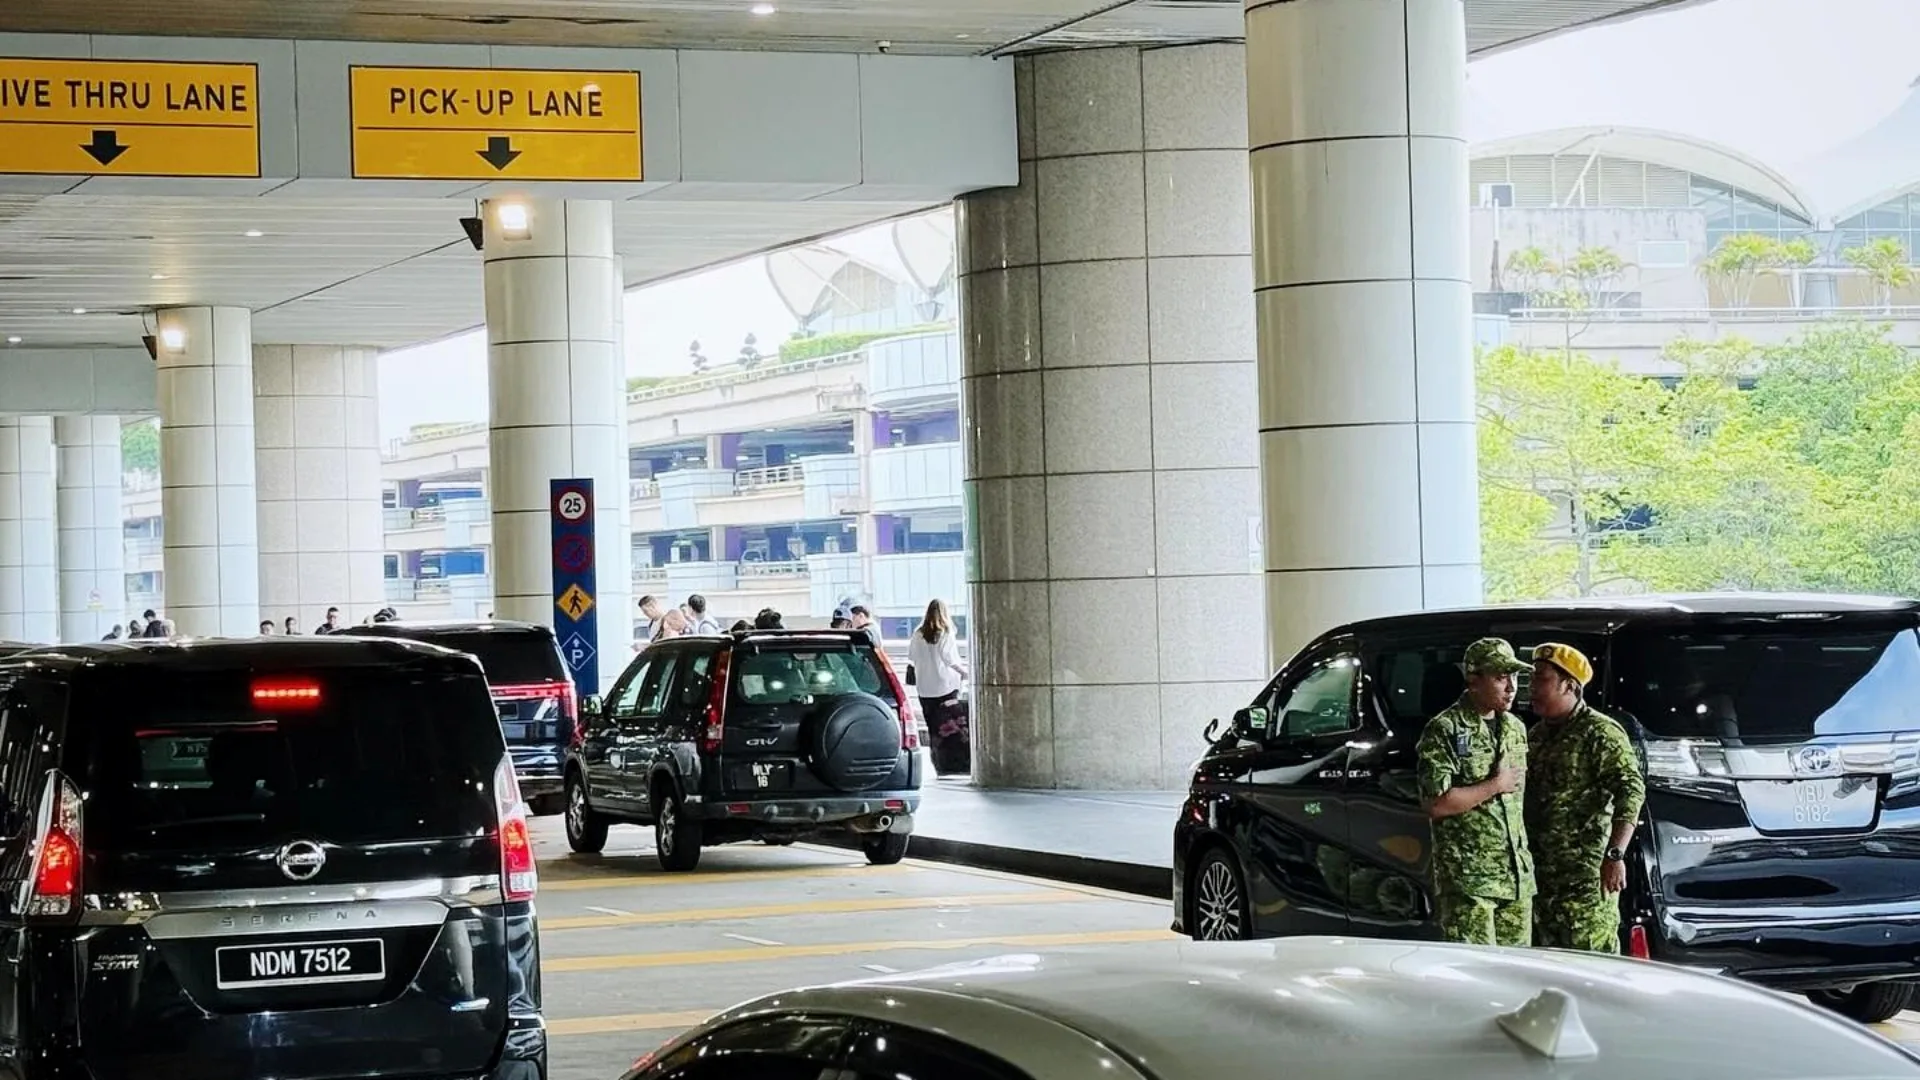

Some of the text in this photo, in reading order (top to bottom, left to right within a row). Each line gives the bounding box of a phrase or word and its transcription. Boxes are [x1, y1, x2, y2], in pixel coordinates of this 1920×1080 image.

[65, 80, 151, 109] THRU
[166, 82, 247, 111] LANE
[389, 87, 603, 116] PICK-UP LANE
[564, 498, 581, 513] 25
[572, 649, 584, 664] P
[1793, 804, 1831, 823] 6182
[250, 947, 351, 977] NDM 7512
